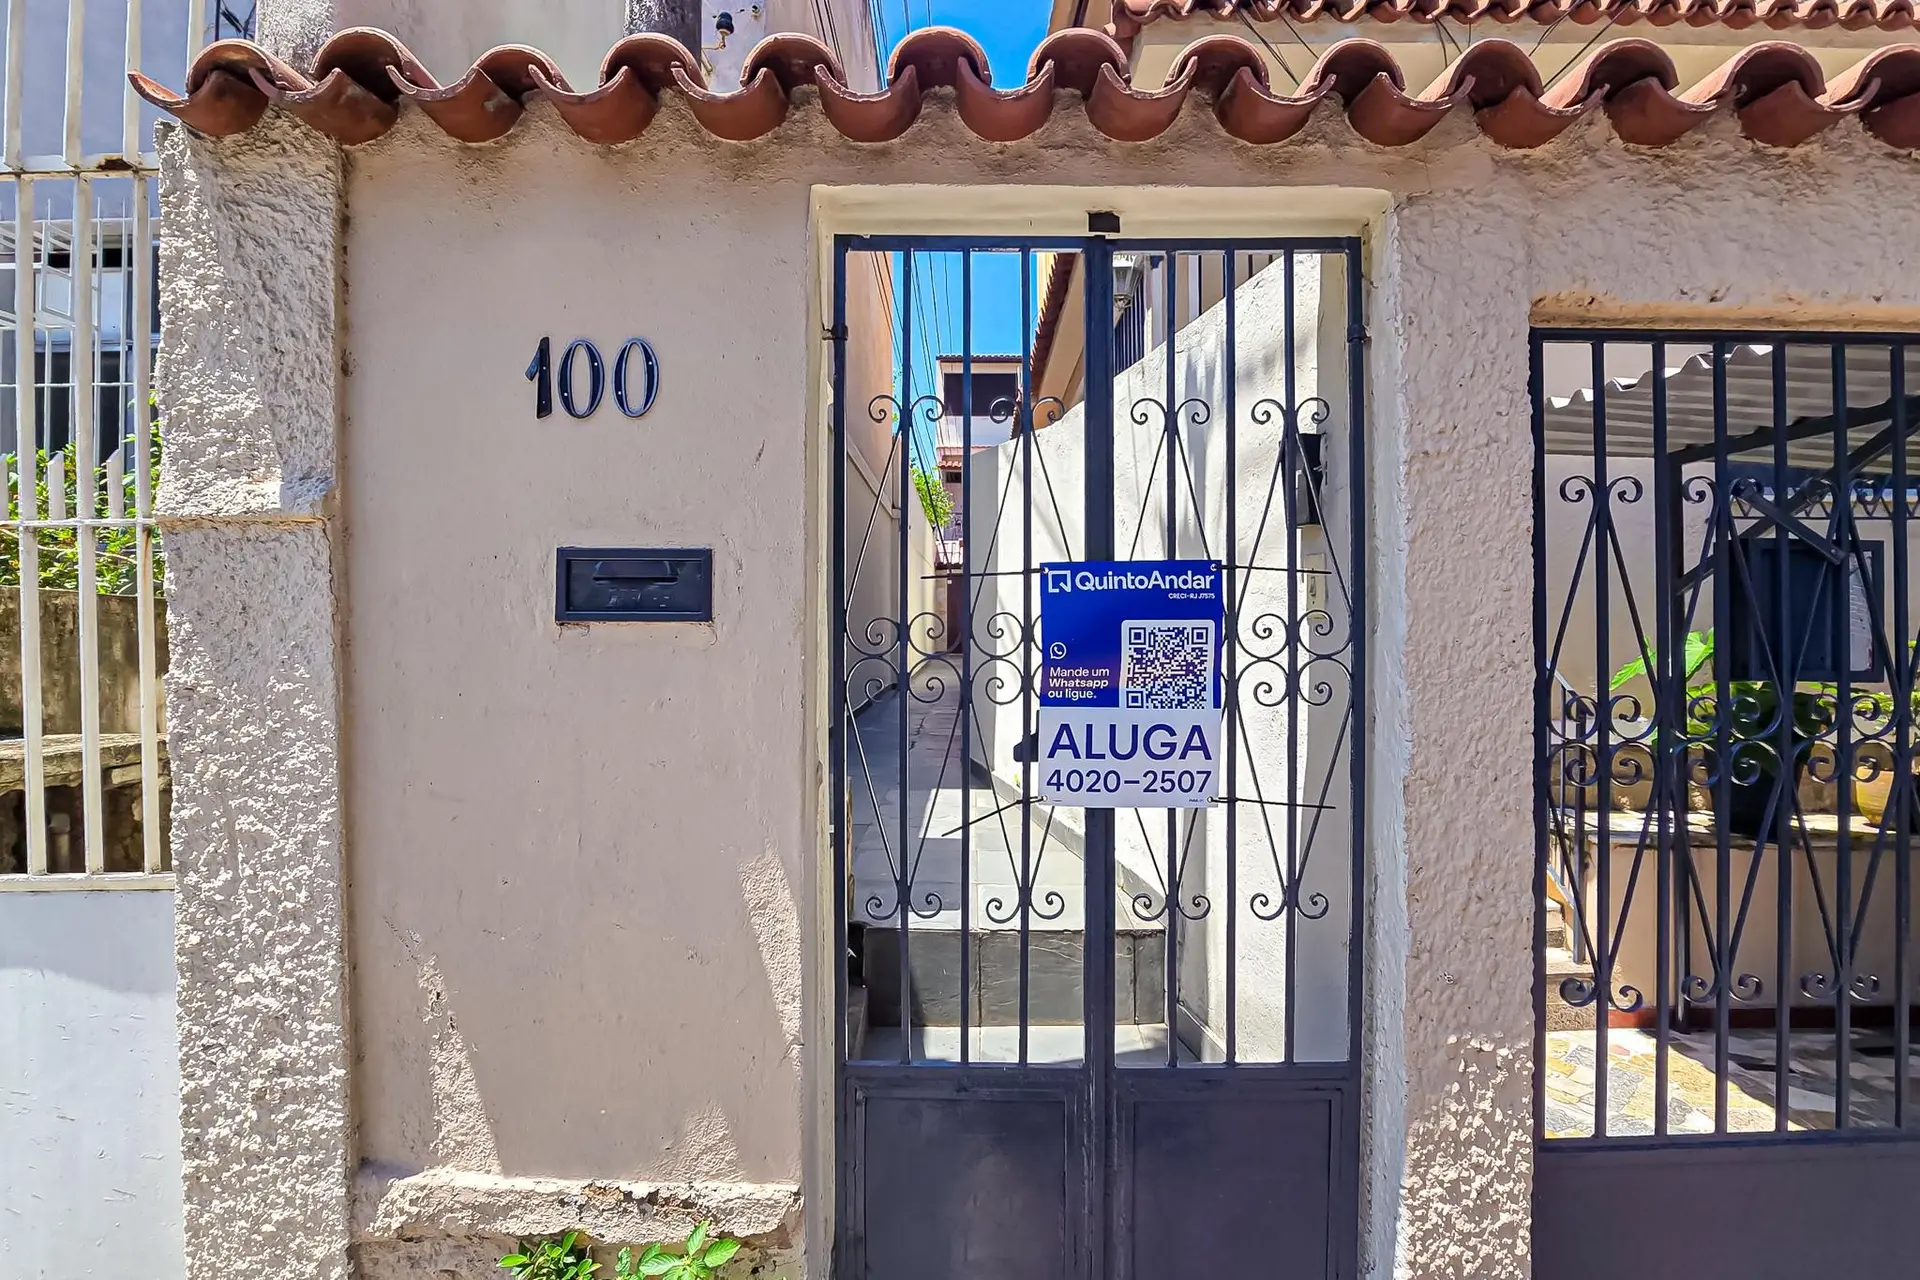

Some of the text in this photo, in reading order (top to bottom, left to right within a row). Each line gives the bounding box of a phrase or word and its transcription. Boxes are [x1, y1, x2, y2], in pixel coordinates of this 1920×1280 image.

[524, 336, 660, 419] 100
[1075, 570, 1215, 591] QuintoAndar
[1168, 592, 1198, 600] CRECI-RJ
[1049, 666, 1110, 677] Mande um
[1049, 677, 1109, 689] Whatsapp
[1048, 688, 1097, 701] ou ligue.
[1047, 723, 1212, 761] ALUGA
[1046, 769, 1212, 793] 4020-2507
